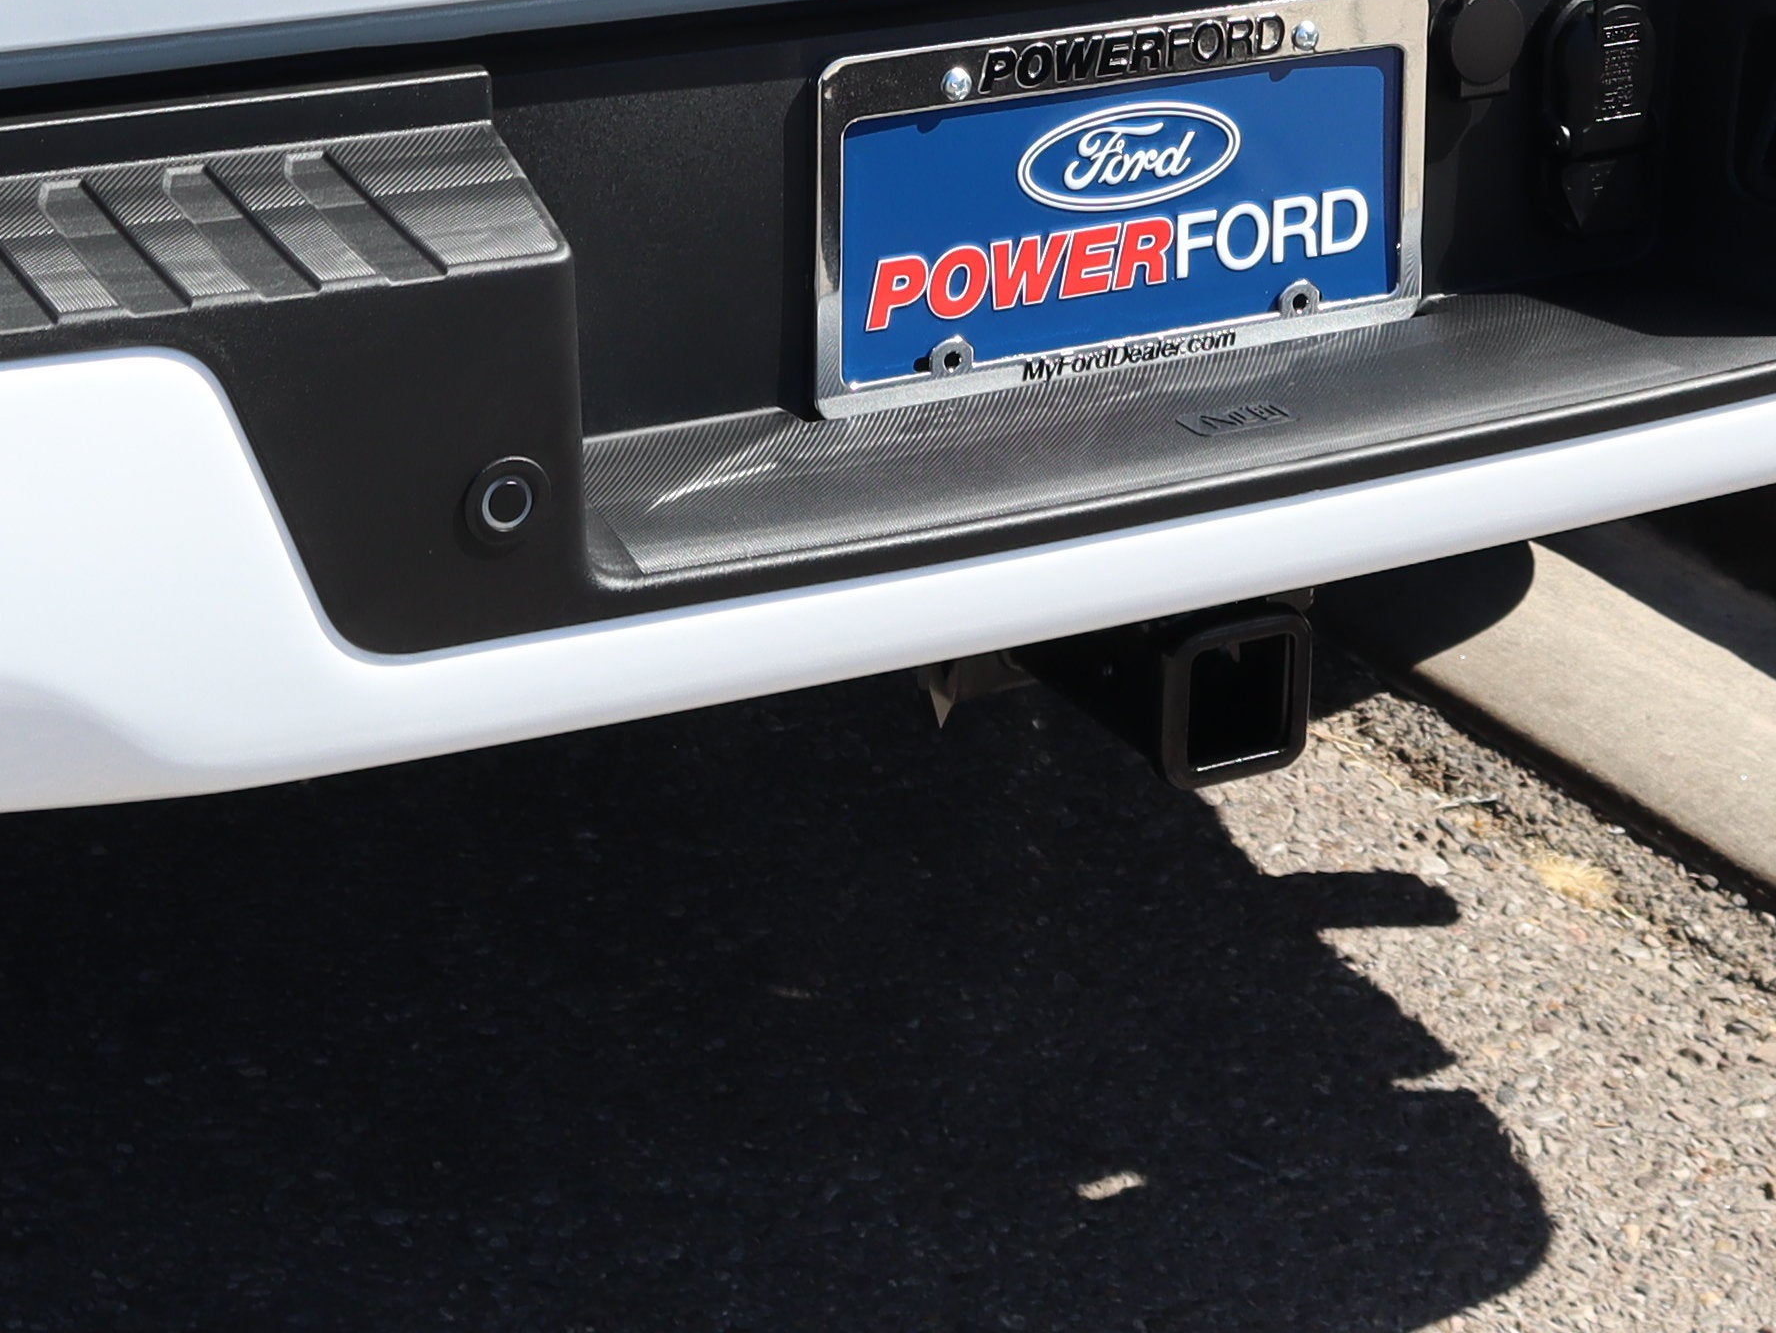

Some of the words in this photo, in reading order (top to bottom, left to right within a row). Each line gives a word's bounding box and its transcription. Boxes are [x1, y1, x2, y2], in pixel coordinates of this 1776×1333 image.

[978, 13, 1286, 95] POWERFORD
[1063, 121, 1196, 191] Ford
[864, 187, 1370, 332] POWERFORD
[1022, 329, 1238, 383] MyFordDealer.com
